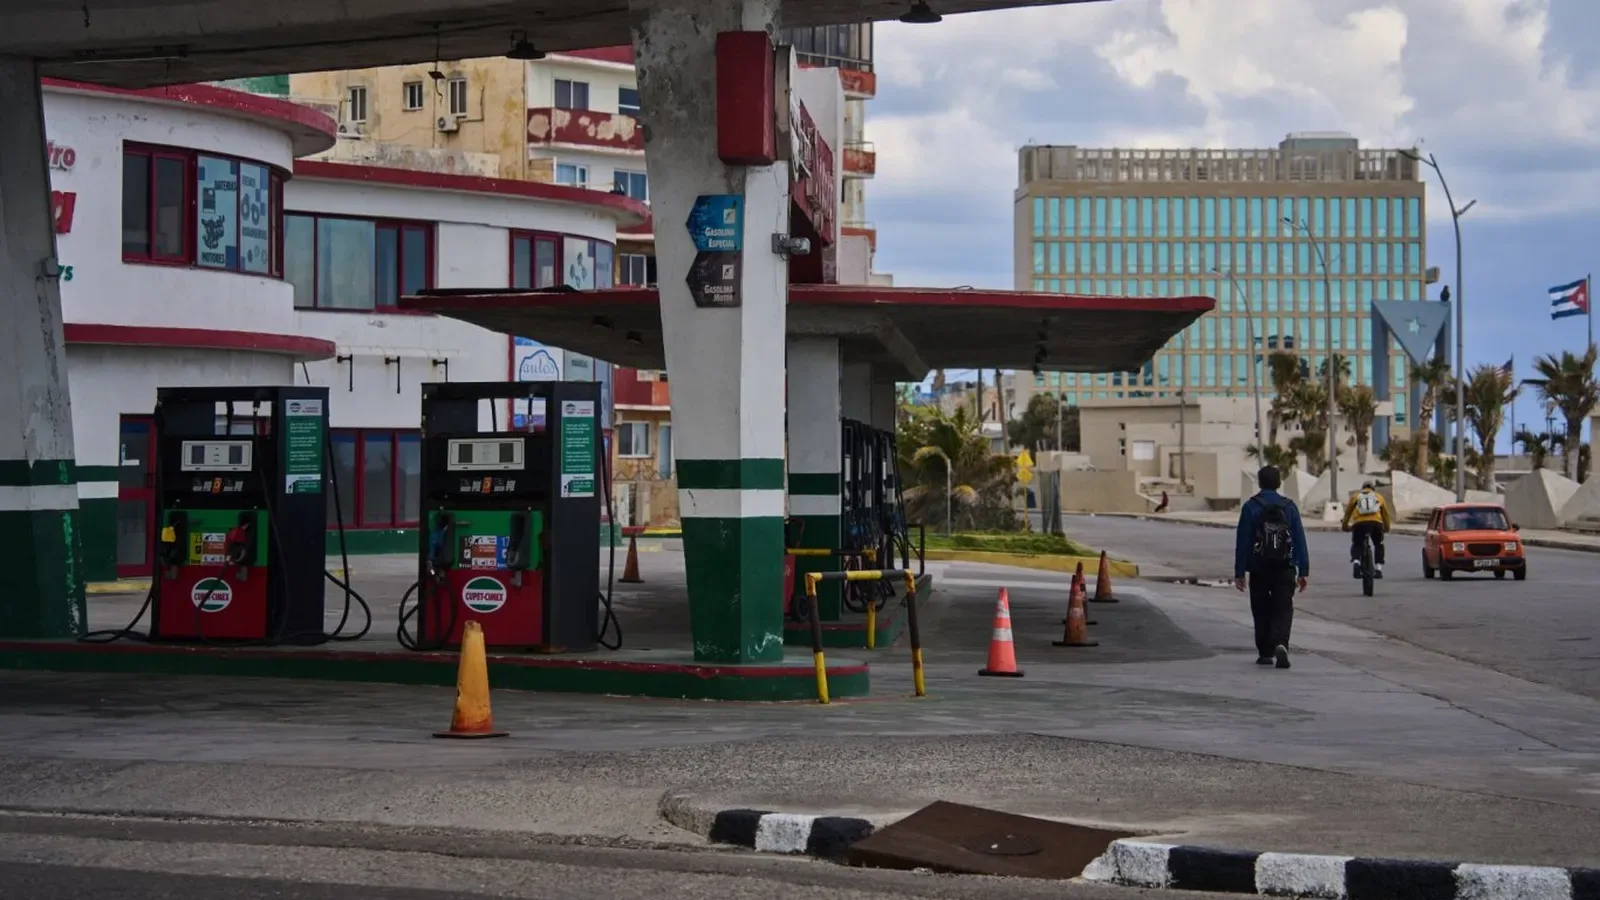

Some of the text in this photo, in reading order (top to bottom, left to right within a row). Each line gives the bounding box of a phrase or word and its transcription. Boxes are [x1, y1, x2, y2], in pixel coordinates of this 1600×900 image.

[705, 227, 735, 237] GASOLINA
[708, 238, 735, 248] ESPECIAL
[704, 284, 733, 293] GASOLINA
[466, 592, 504, 601] CUPET-CIMEX
